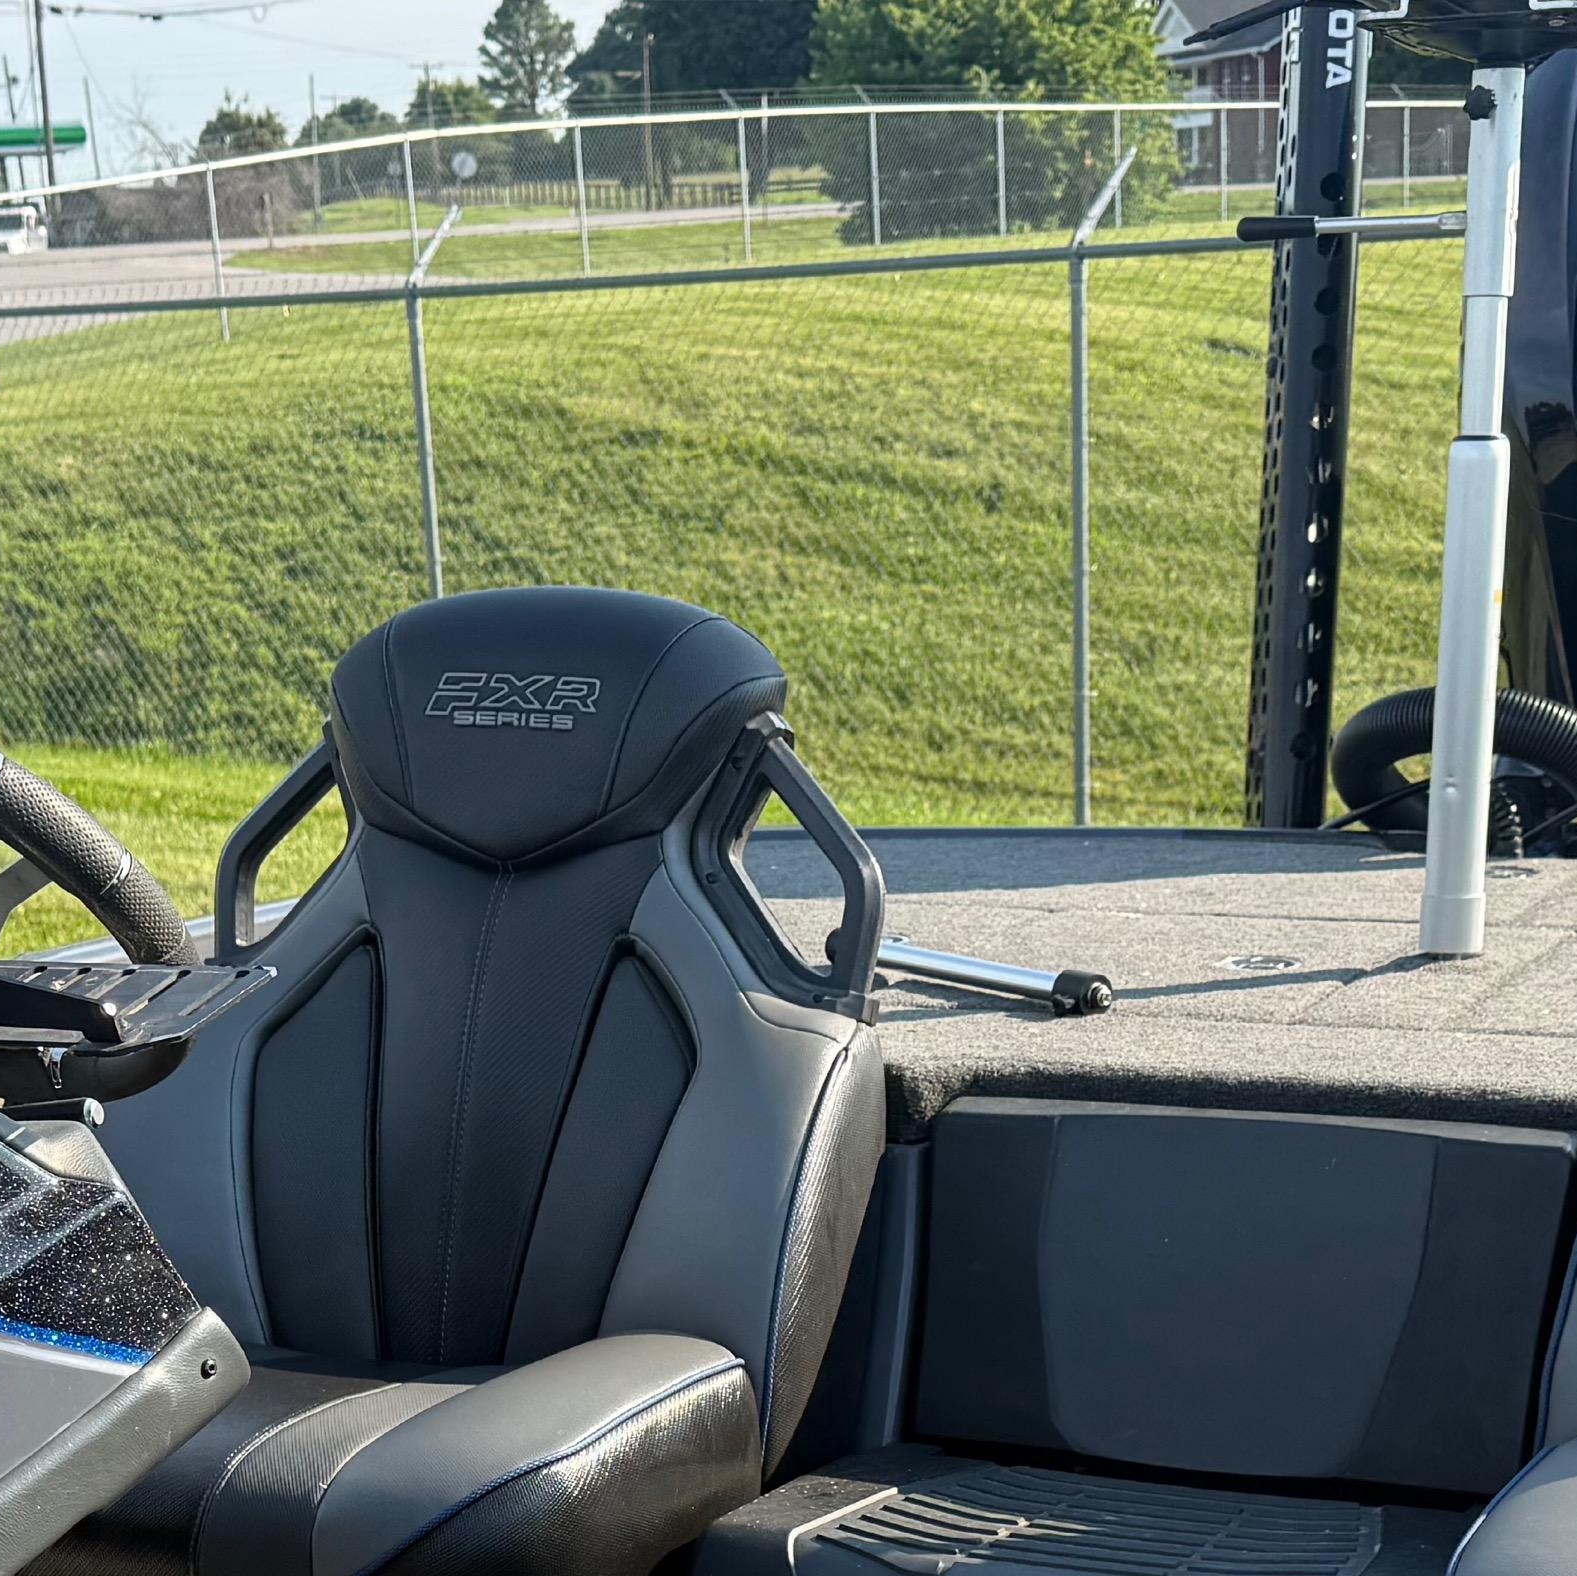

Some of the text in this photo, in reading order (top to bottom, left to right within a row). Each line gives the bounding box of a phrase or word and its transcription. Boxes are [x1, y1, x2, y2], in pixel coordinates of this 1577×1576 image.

[1326, 9, 1355, 89] OTA
[424, 672, 601, 716] FXR
[452, 710, 574, 730] SERIES
